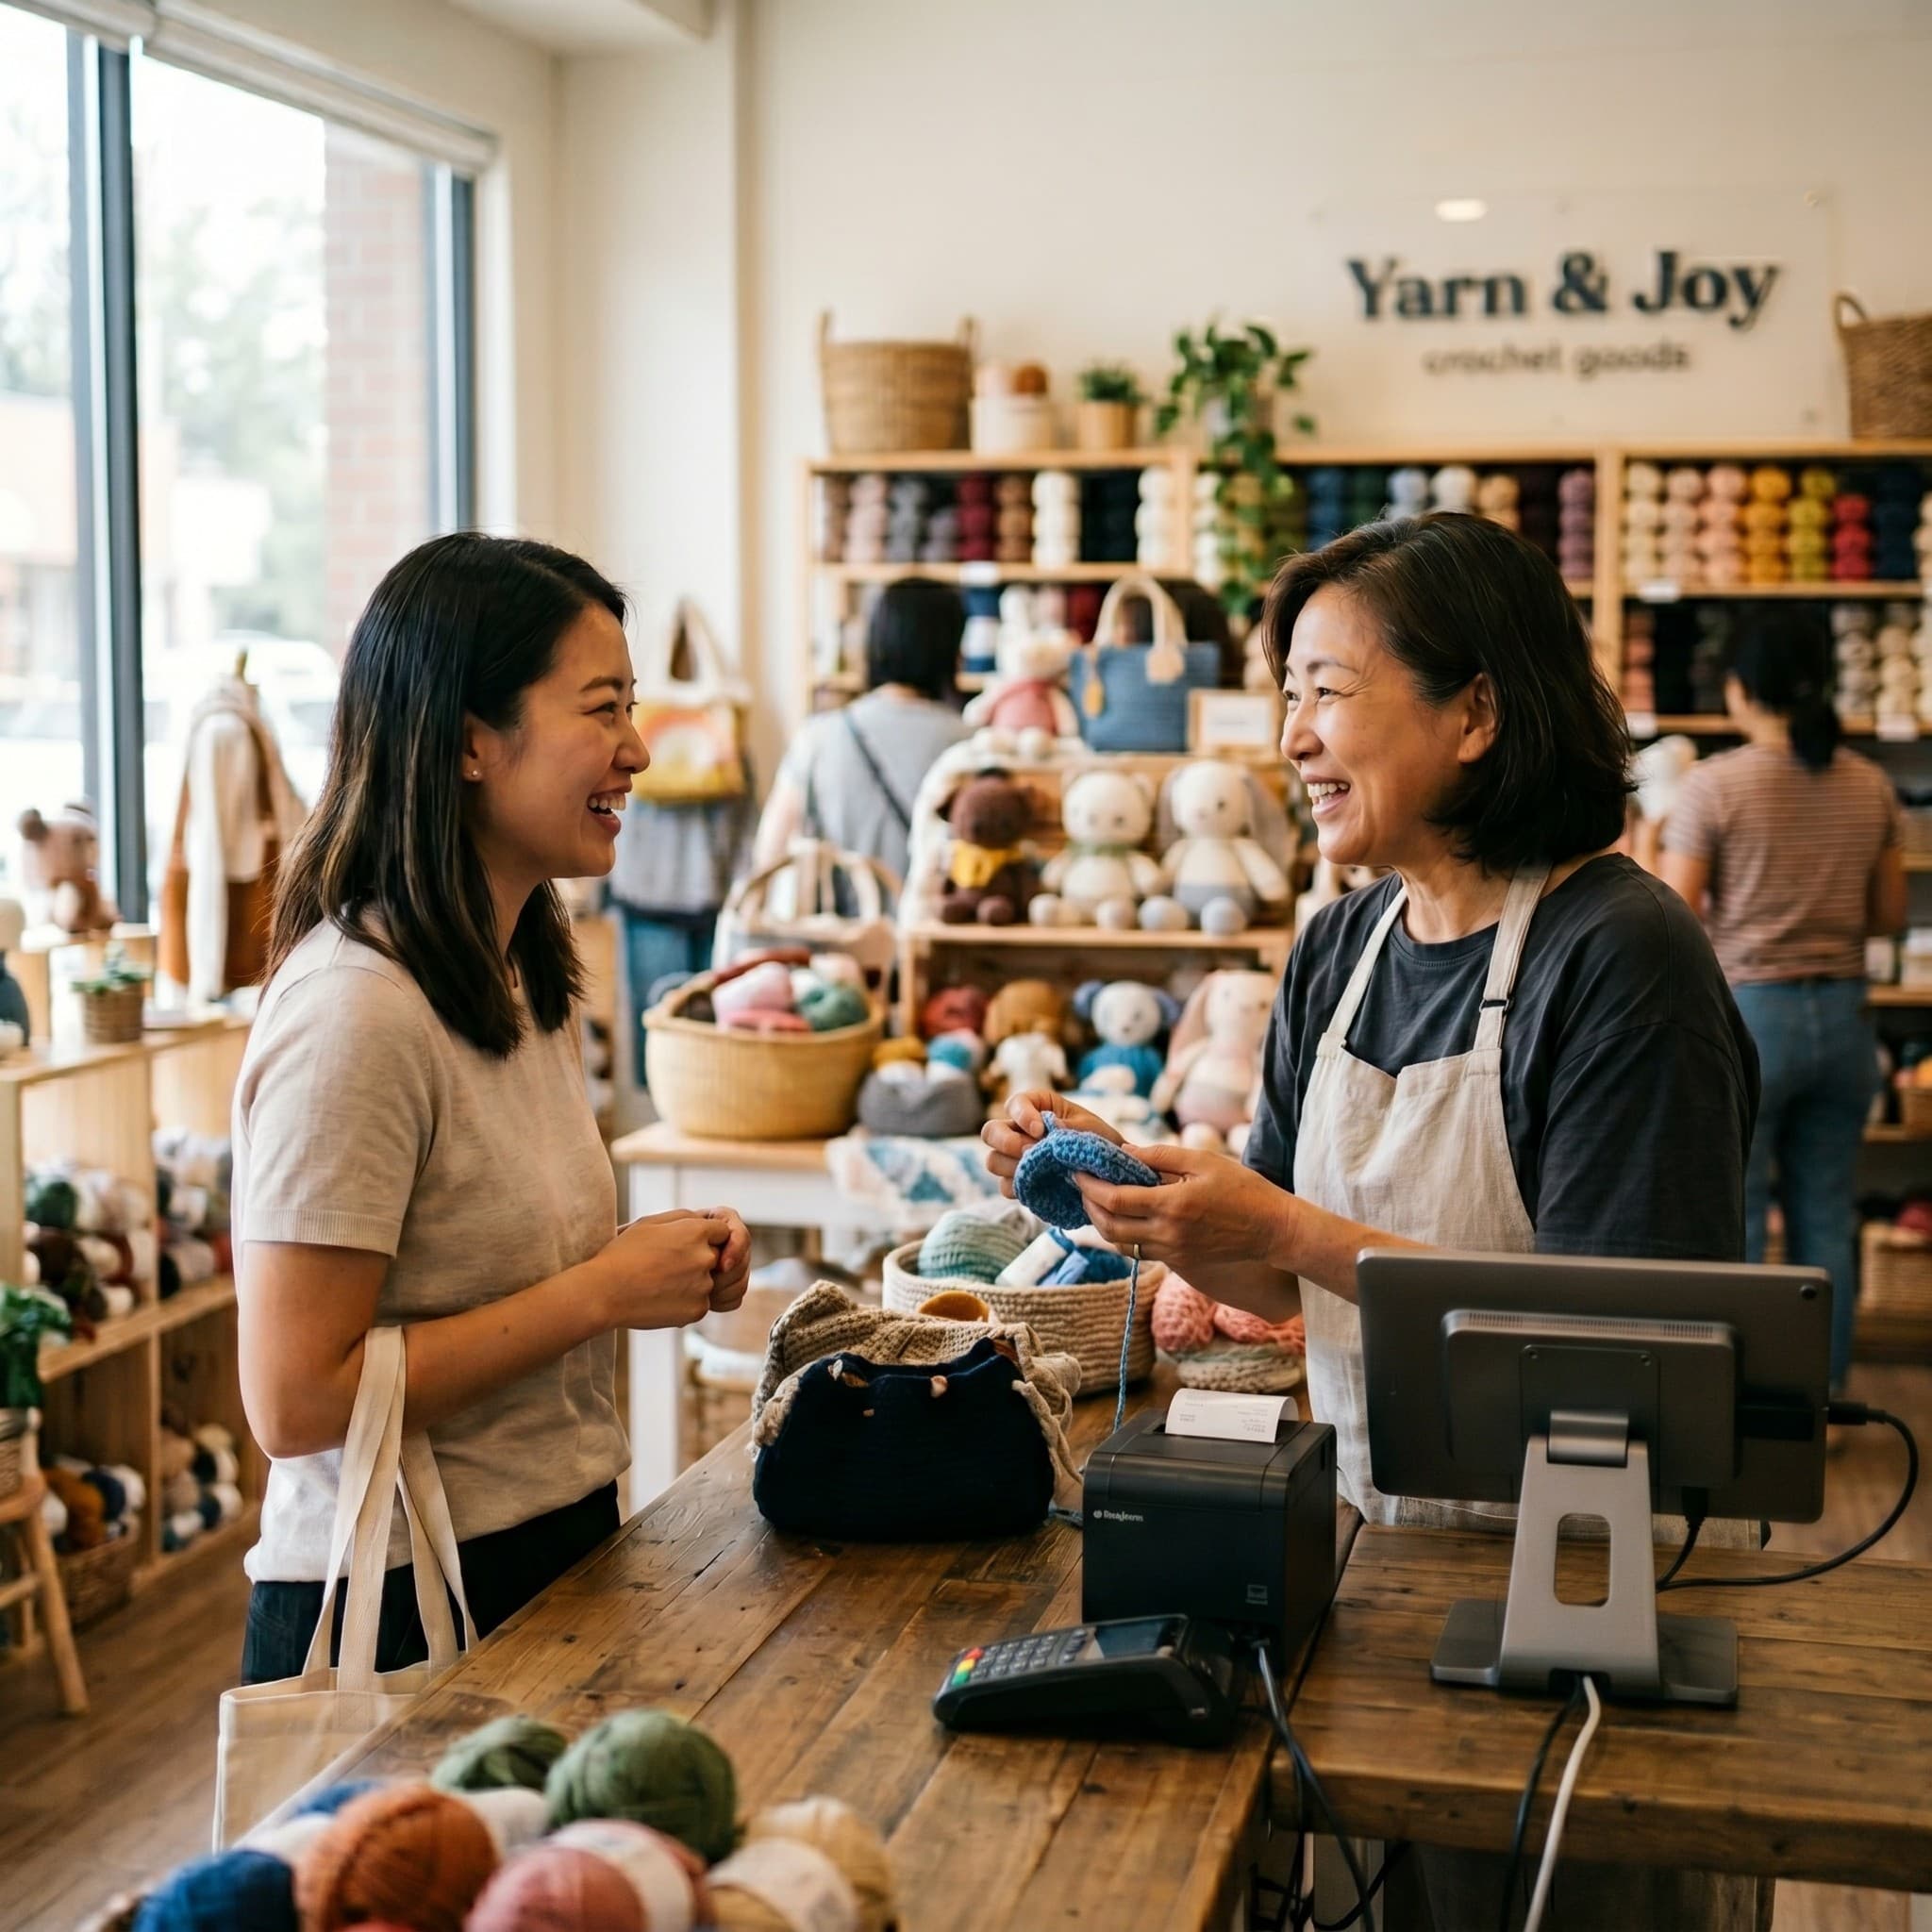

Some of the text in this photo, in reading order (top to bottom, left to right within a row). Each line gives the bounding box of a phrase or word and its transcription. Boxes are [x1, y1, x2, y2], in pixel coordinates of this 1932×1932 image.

[1346, 250, 1780, 330] Yarn & Joy
[1423, 340, 1691, 380] crochet goods
